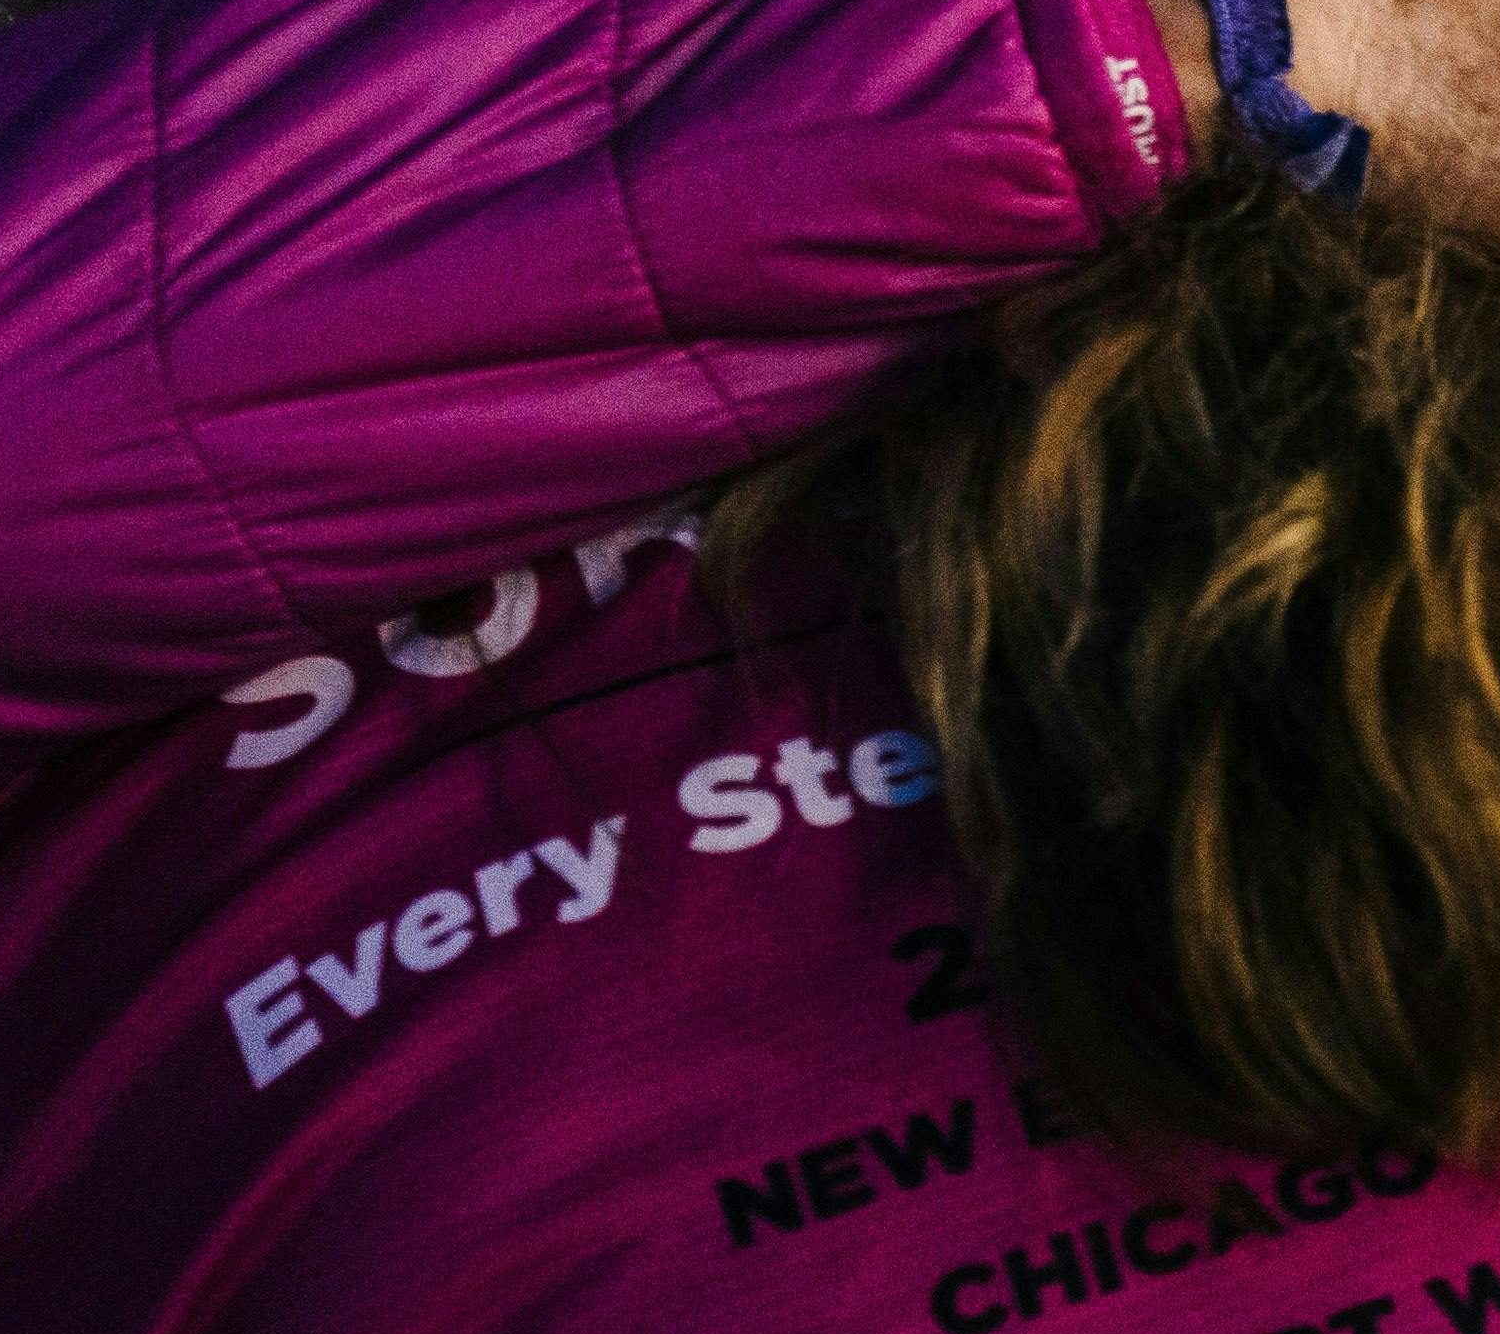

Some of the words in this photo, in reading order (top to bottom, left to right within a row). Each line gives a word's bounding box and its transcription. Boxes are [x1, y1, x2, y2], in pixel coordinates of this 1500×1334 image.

[222, 814, 627, 1090] Every
[677, 730, 938, 854] Ste
[714, 1099, 977, 1249] NEW
